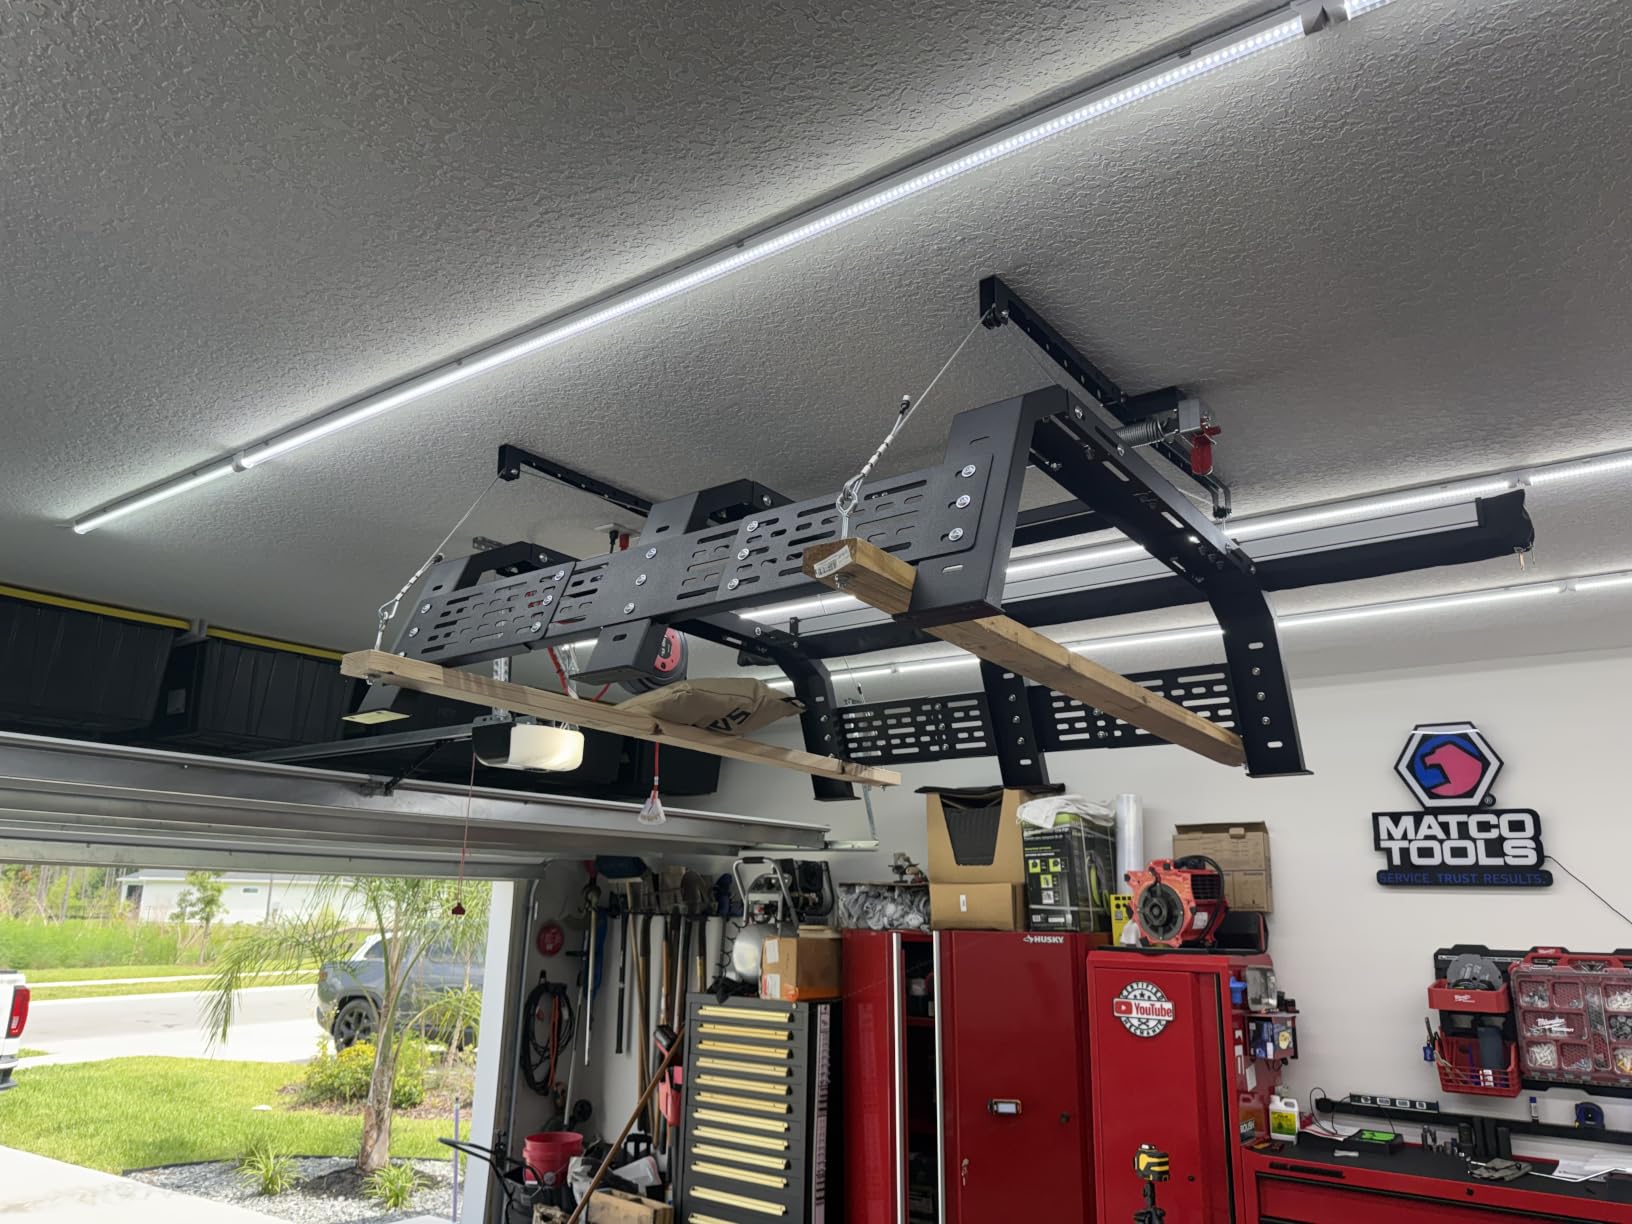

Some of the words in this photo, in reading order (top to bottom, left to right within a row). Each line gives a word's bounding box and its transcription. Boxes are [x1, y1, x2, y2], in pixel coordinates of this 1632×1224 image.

[1378, 812, 1535, 840] MATCO
[1380, 839, 1538, 866] TOOLS
[1034, 935, 1065, 944] HUSKY
[1134, 1002, 1173, 1018] YouTube
